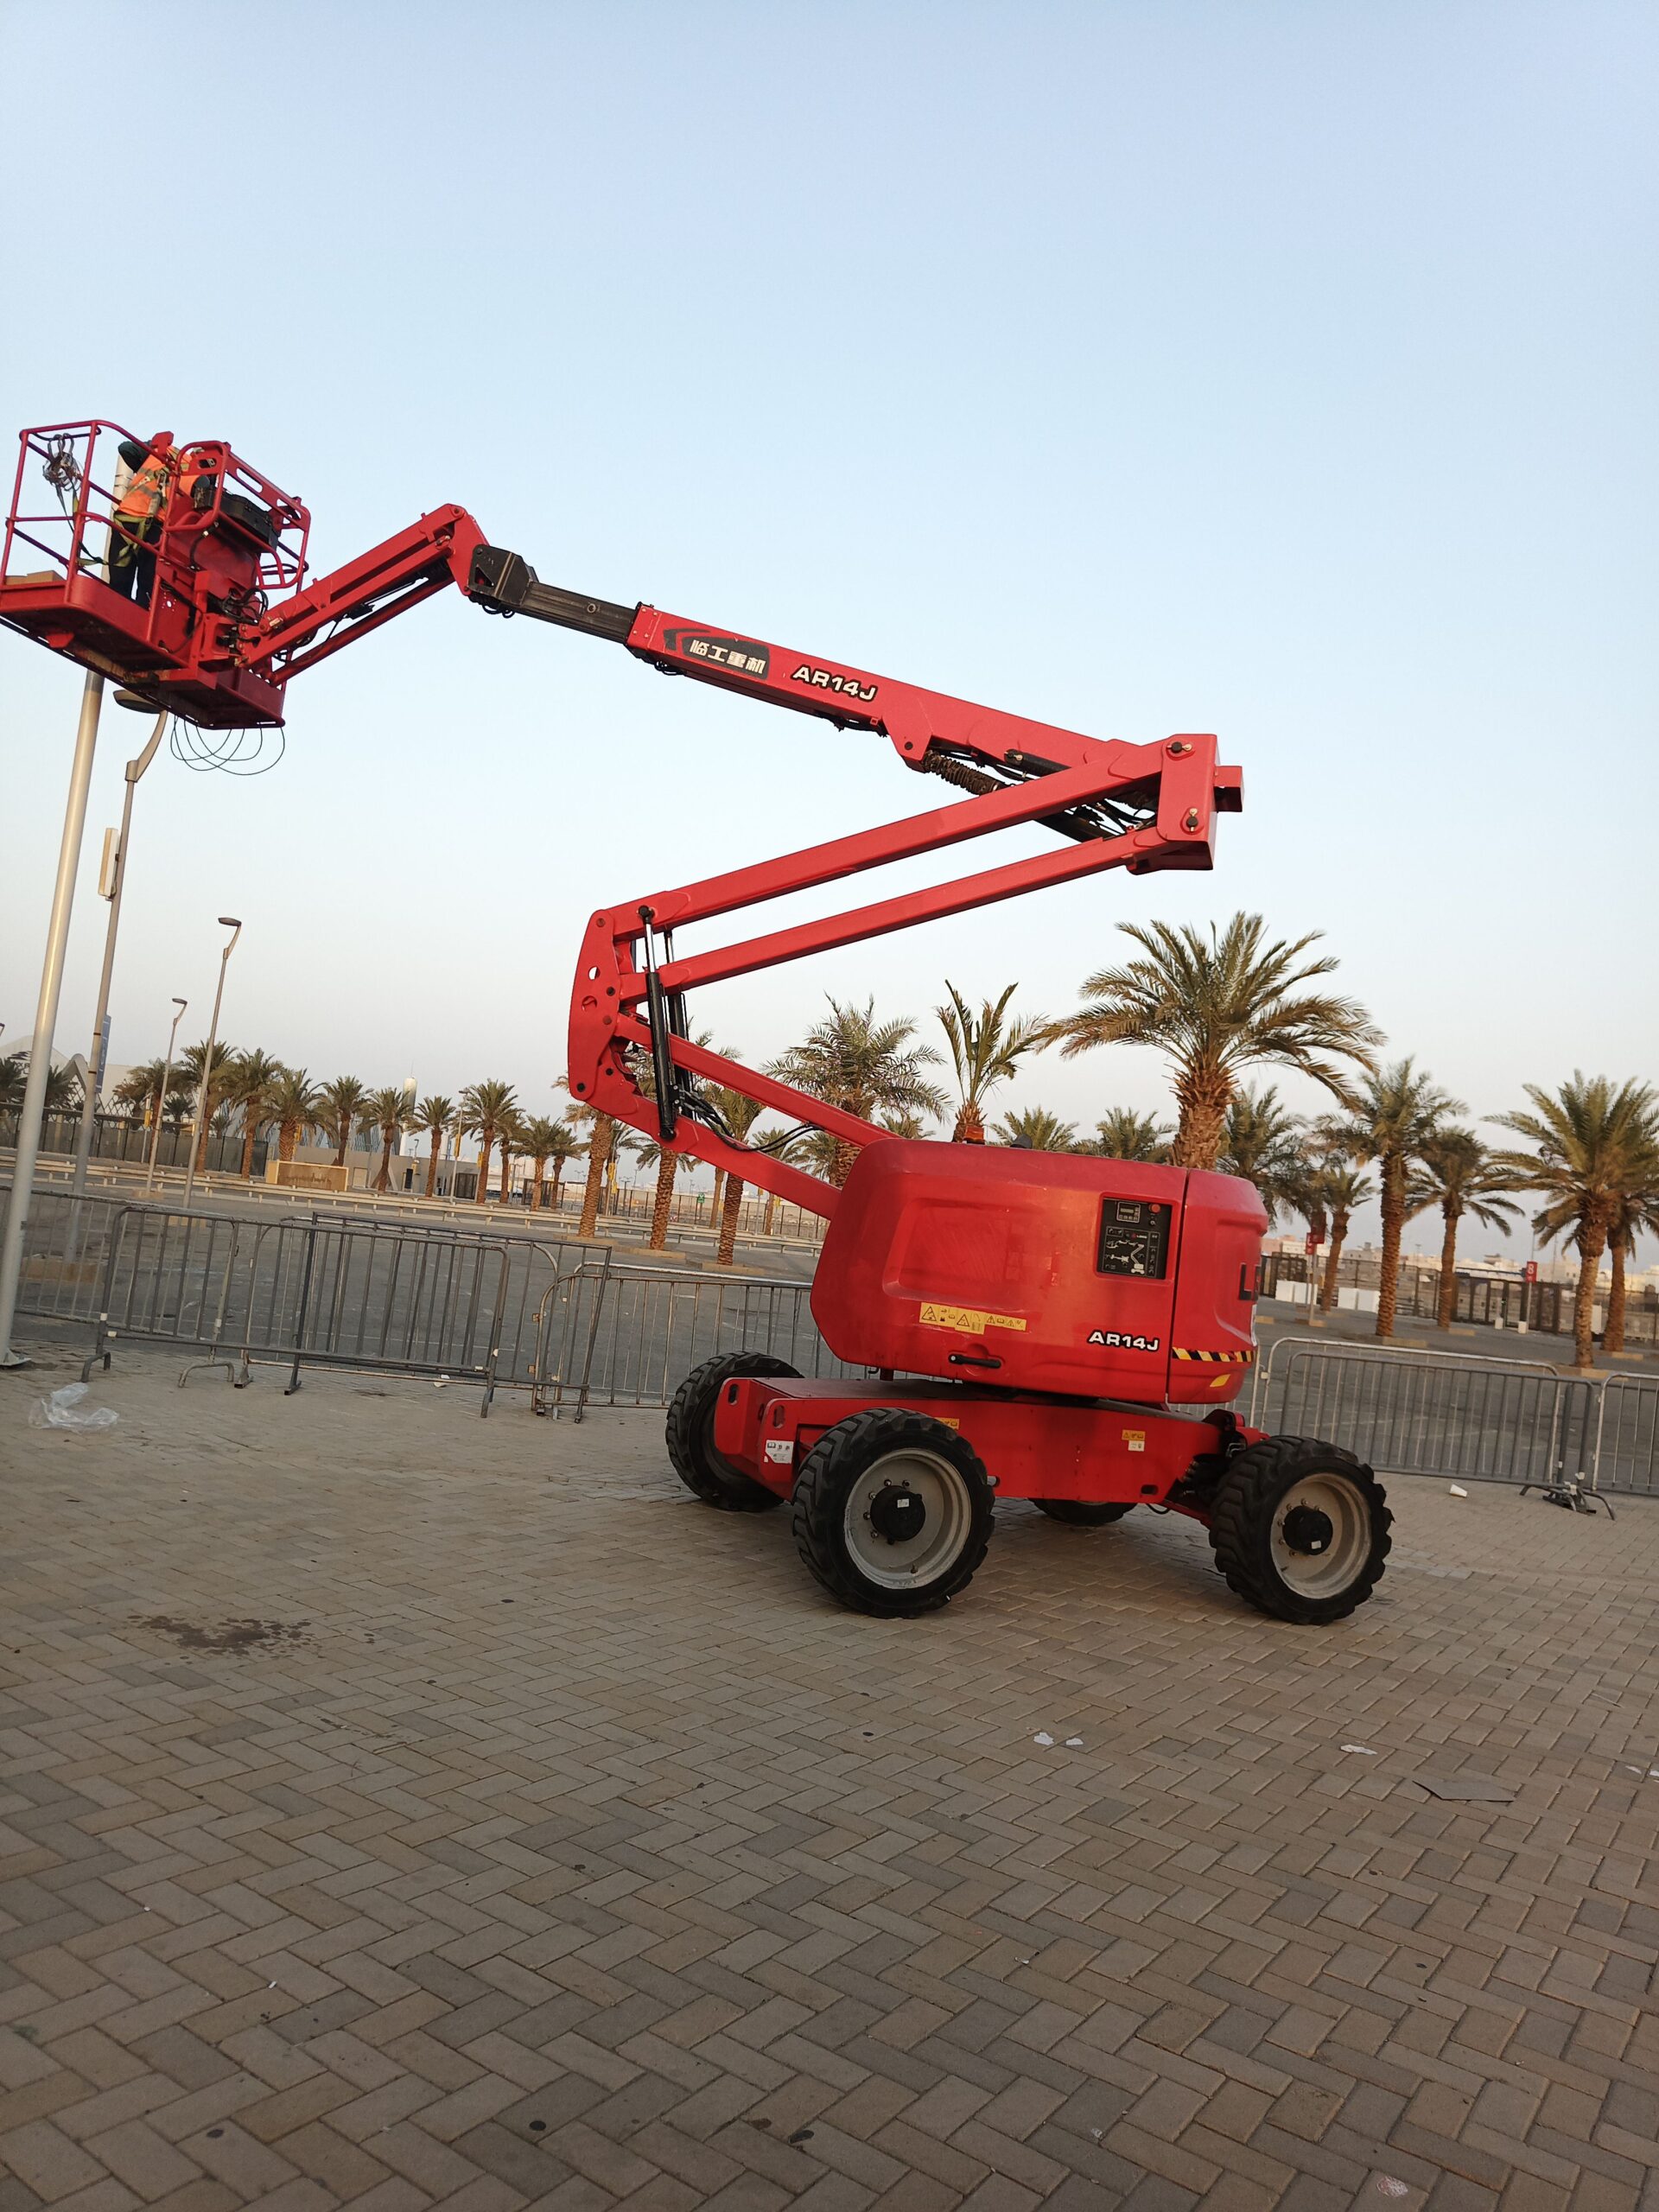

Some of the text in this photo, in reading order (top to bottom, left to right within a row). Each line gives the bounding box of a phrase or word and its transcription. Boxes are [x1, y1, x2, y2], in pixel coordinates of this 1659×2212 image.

[689, 639, 766, 675] 临工重机
[791, 665, 879, 702] AR14J
[1088, 1331, 1160, 1351] AR14J
